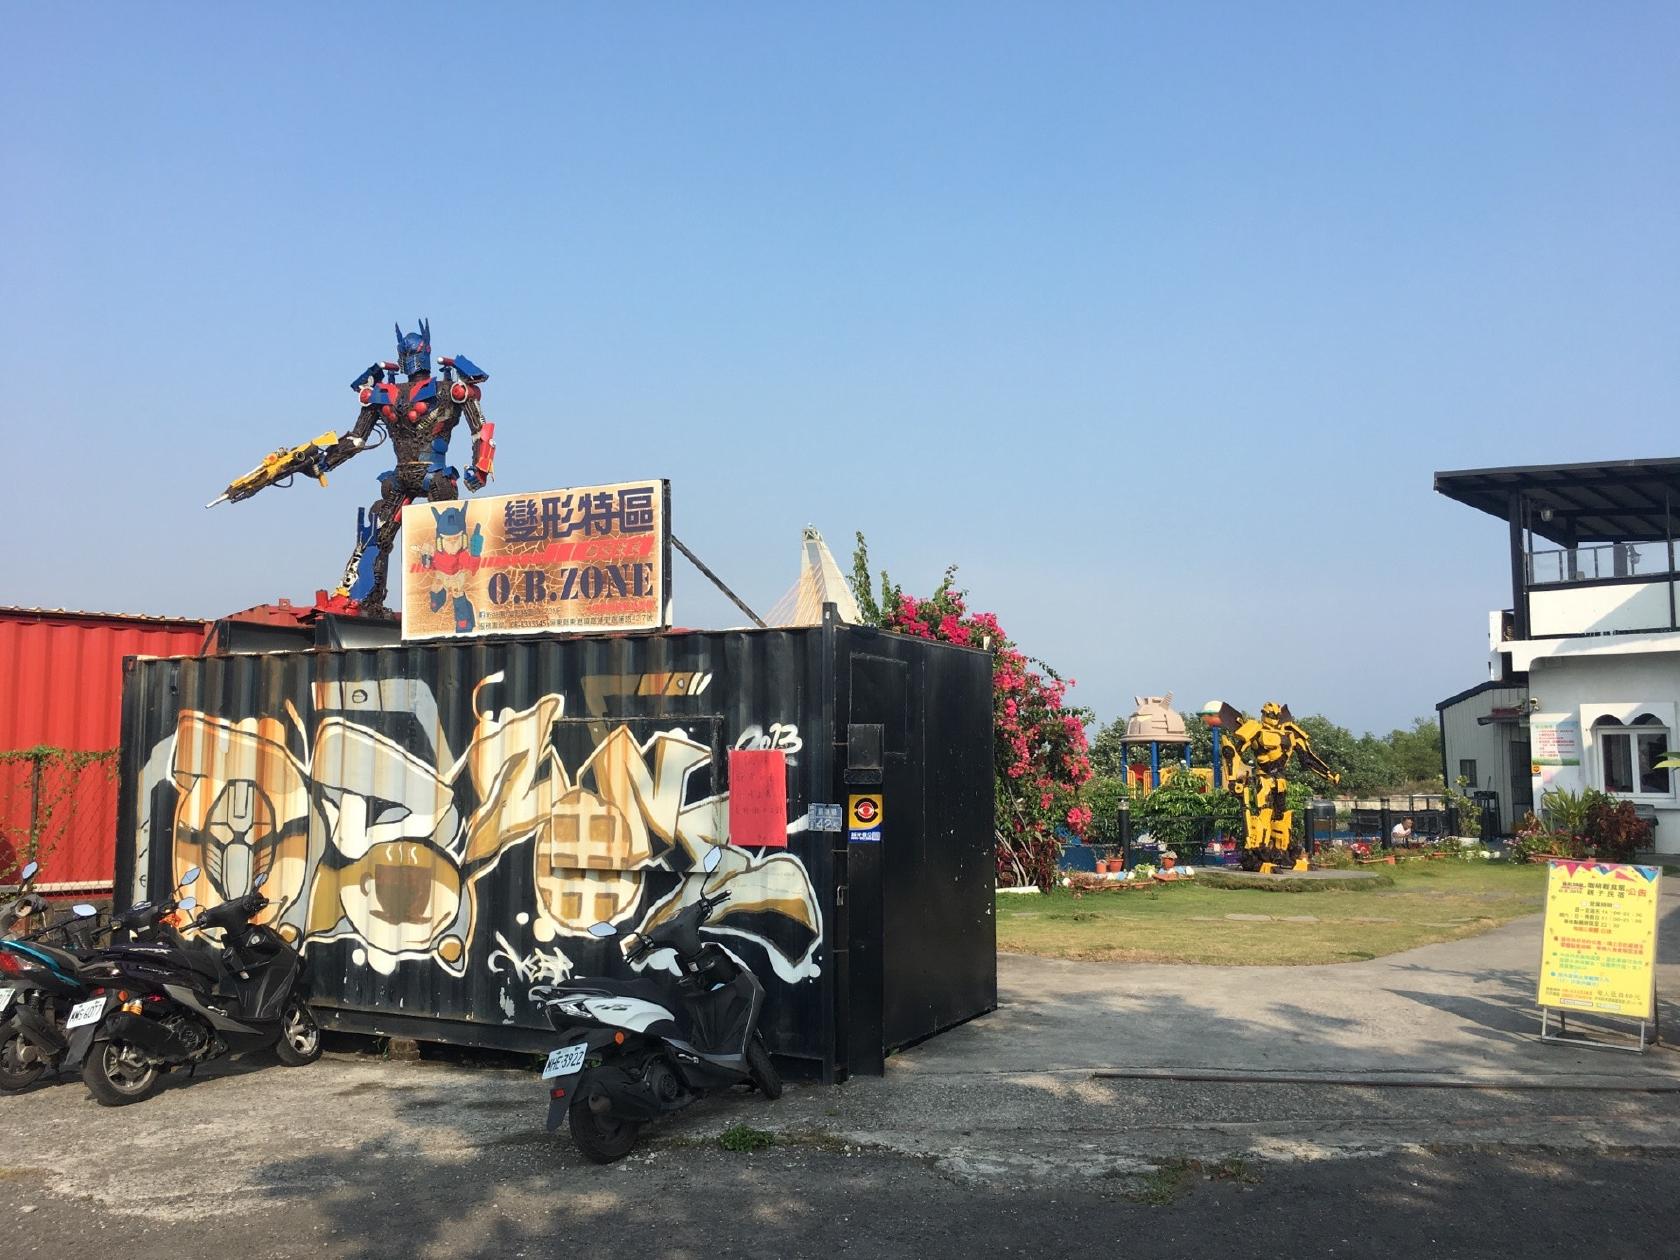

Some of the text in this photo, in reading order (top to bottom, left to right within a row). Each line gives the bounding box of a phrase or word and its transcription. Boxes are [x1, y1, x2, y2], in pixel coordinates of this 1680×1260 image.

[505, 486, 654, 542] 變形特區
[488, 562, 654, 605] O.B.ZONE
